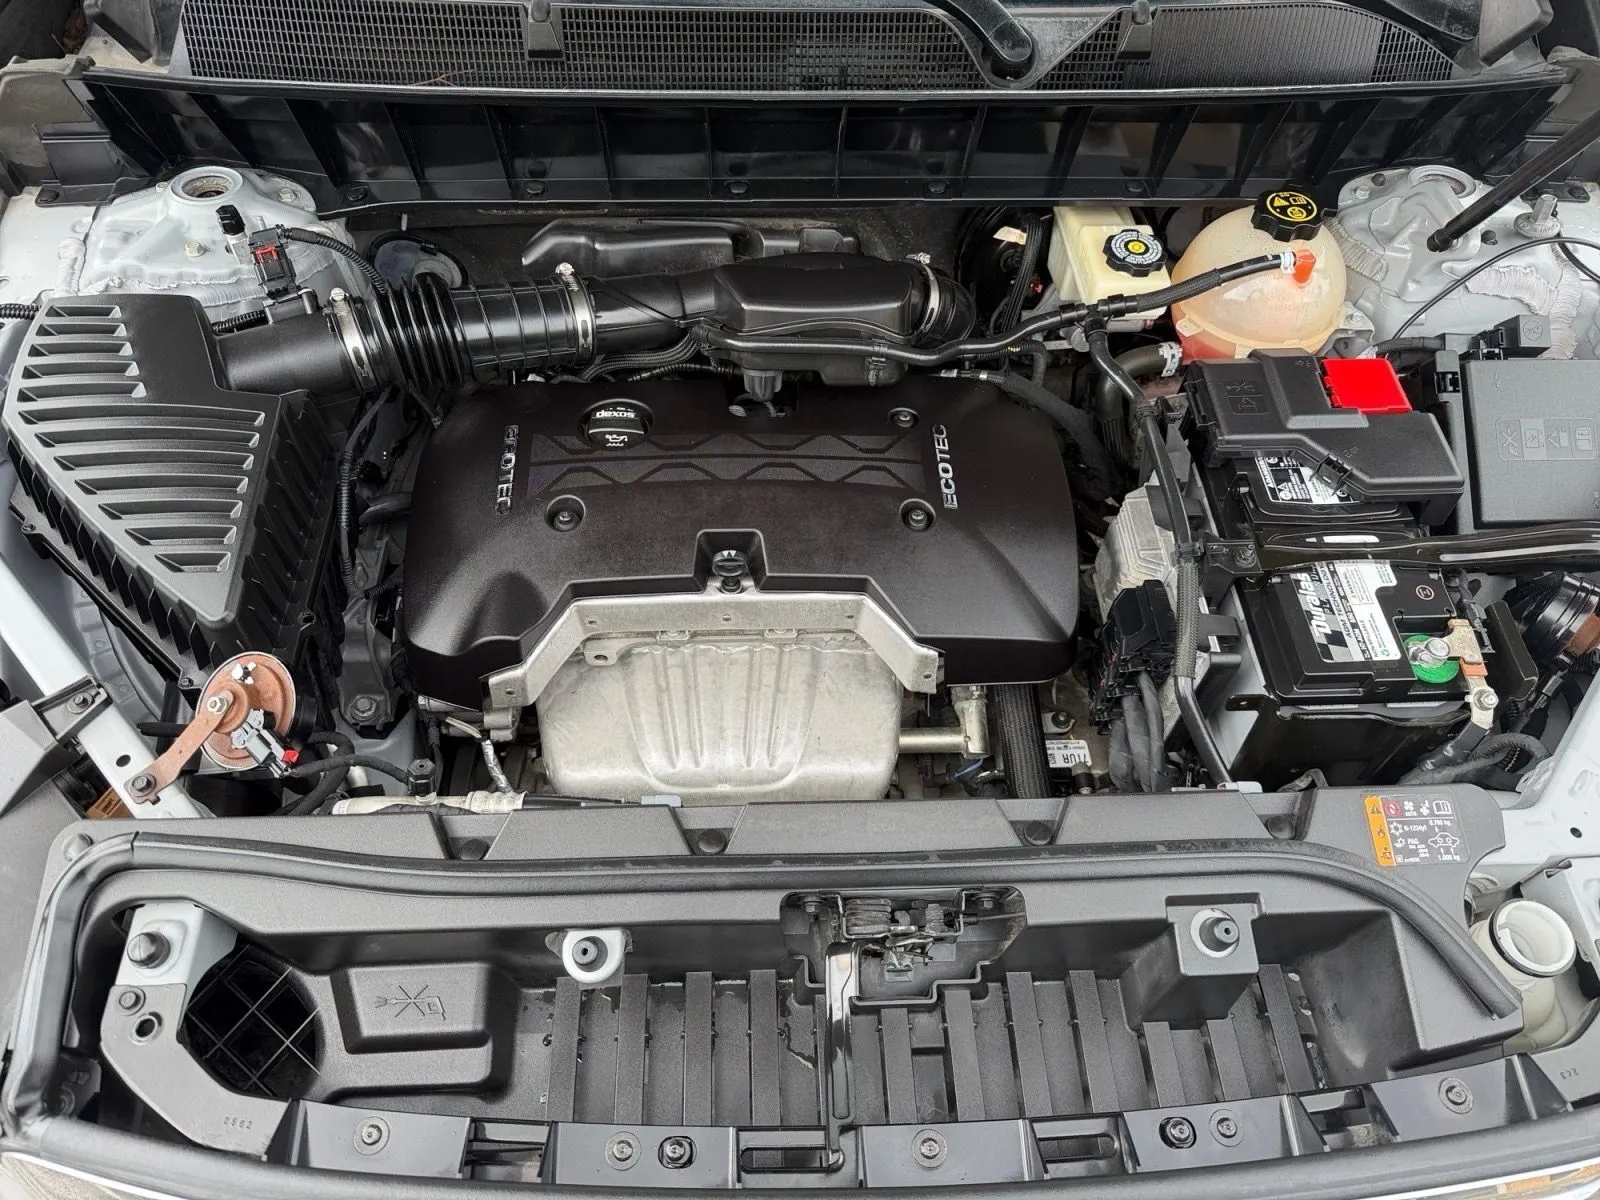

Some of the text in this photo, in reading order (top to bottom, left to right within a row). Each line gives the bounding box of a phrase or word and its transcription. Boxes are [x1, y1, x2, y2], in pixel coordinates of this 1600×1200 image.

[596, 409, 635, 418] dexos
[495, 424, 519, 516] ECOTEC
[932, 424, 958, 509] ECOTEC
[1297, 572, 1332, 637] Duralas
[1340, 619, 1353, 639] AGM
